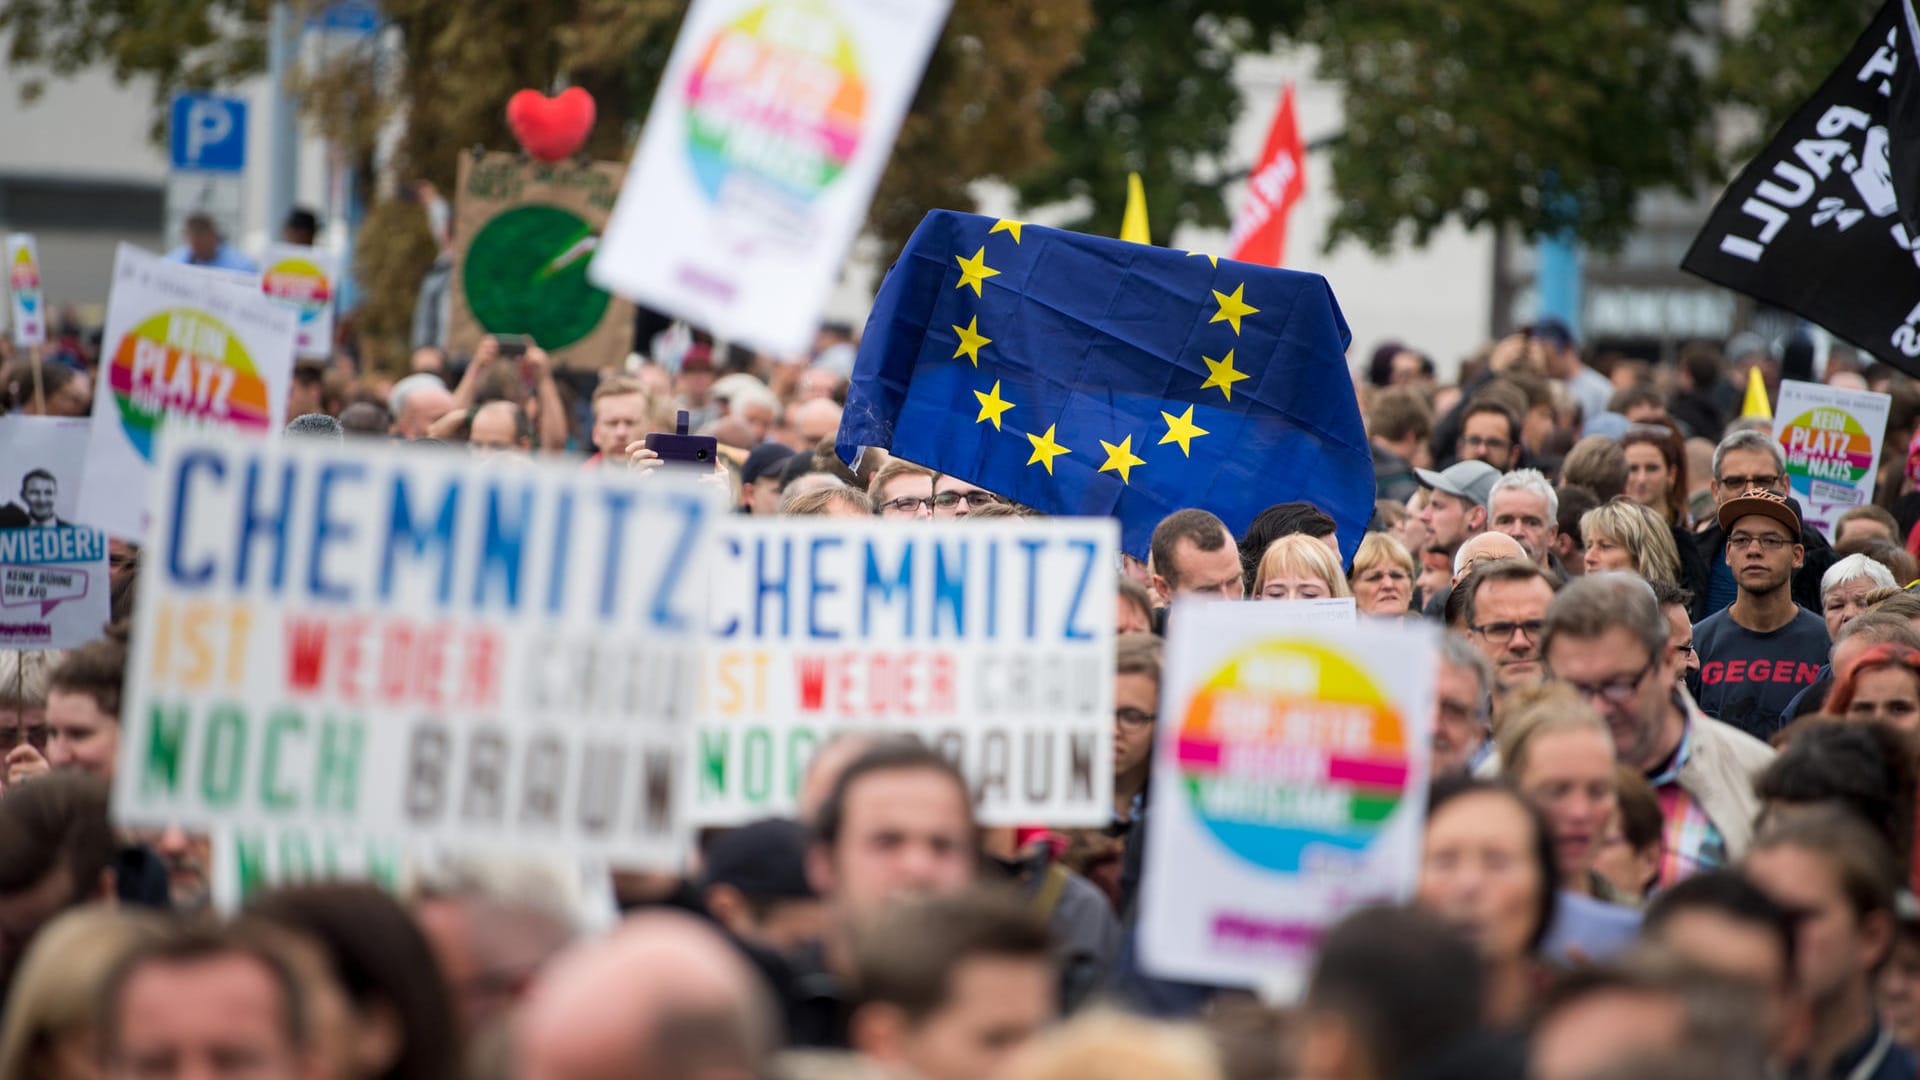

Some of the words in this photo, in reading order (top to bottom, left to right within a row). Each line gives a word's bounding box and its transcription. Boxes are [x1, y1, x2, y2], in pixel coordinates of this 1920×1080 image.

[187, 99, 233, 161] P
[166, 312, 229, 364] KEIN
[130, 337, 237, 416] PLATZ
[1790, 426, 1851, 459] PLATZ
[1811, 408, 1846, 432] KEIN
[1807, 457, 1853, 482] NAZIS
[165, 449, 711, 633] CHEMNITZ
[5, 584, 25, 597] DER
[6, 570, 34, 583] KEINE
[708, 536, 1104, 641] CHEMNITZ
[151, 602, 251, 691] IST
[285, 612, 503, 710] WEDER
[795, 653, 957, 715] WEDER
[1701, 658, 1820, 685] GEGEN
[140, 700, 365, 811] NOCH
[403, 718, 685, 843] BRAUN
[699, 725, 822, 803] NOC
